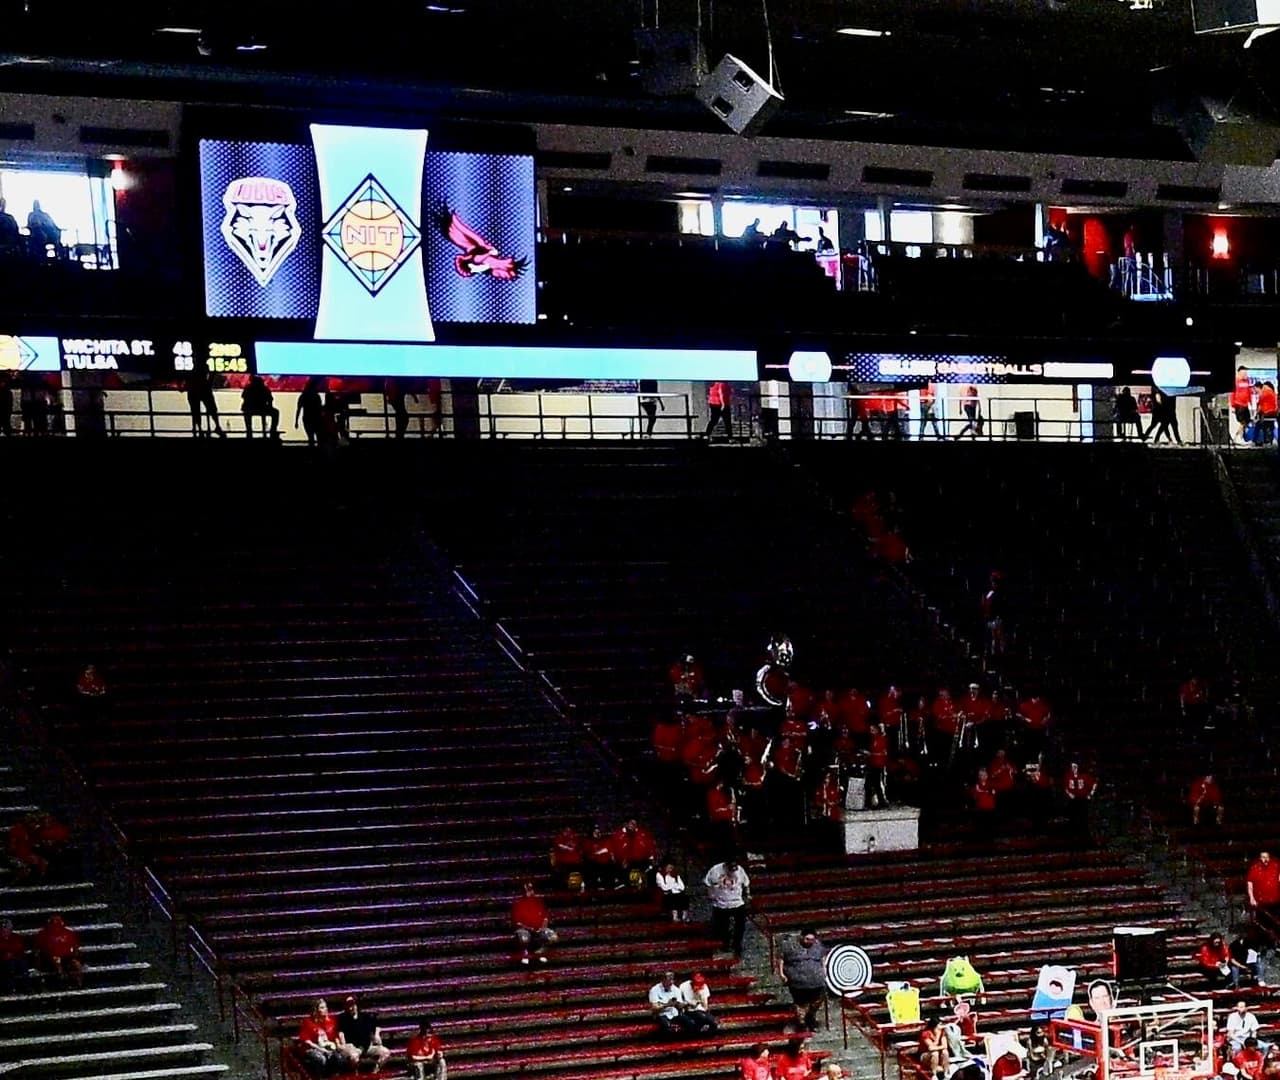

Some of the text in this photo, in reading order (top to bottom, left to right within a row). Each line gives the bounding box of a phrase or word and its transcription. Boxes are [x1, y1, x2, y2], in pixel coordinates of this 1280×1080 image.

[346, 224, 399, 246] NIT
[62, 339, 130, 356] WICHITA
[63, 354, 119, 370] TULSA
[206, 357, 248, 372] 15:45
